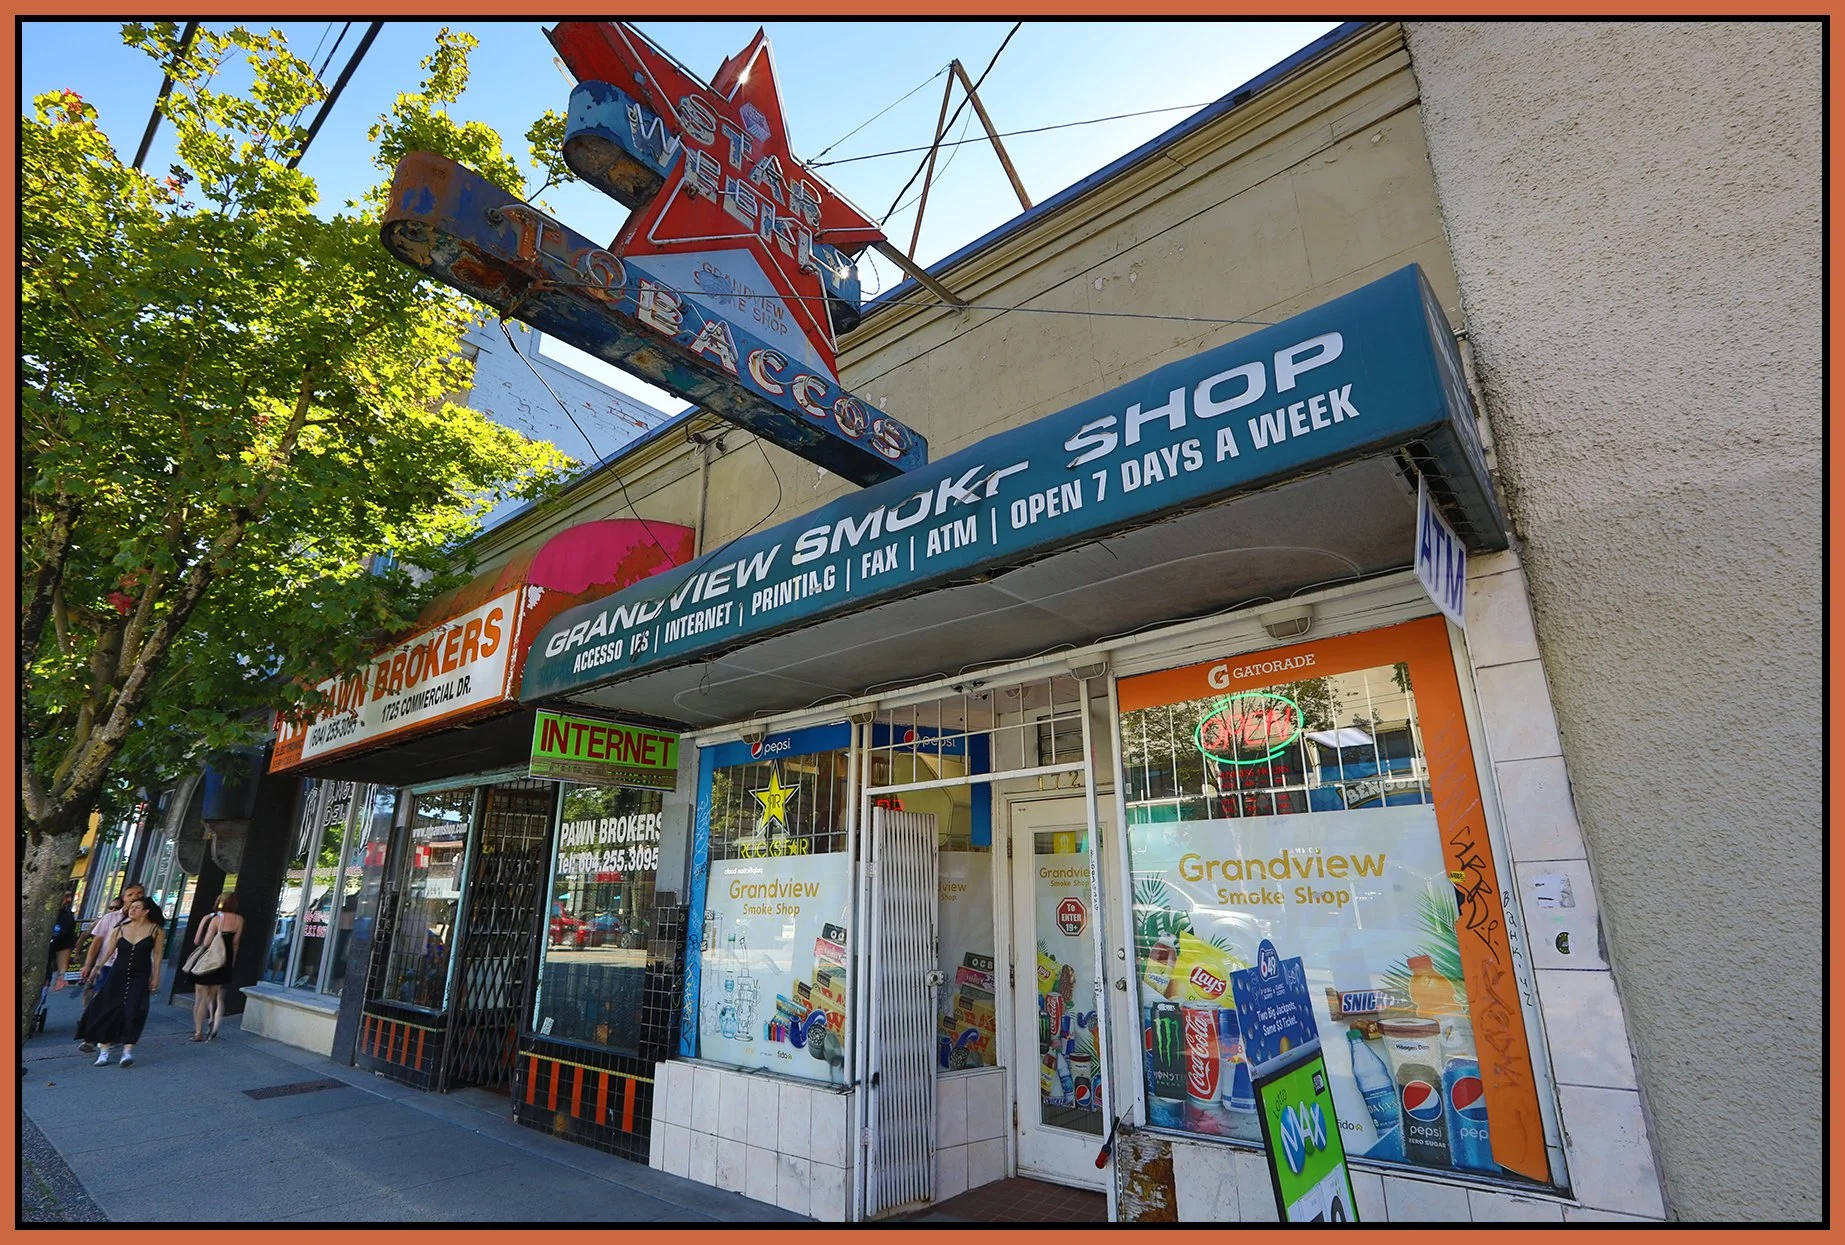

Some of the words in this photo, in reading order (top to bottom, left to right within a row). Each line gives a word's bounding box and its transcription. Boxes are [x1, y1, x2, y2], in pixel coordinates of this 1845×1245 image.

[500, 204, 912, 459] TOBACCOS
[753, 307, 788, 336] SHOP
[1064, 331, 1343, 470] SHOP
[573, 630, 649, 674] ACCESSOIES
[665, 601, 733, 644] INTERNET
[861, 543, 898, 579] FAX
[926, 515, 977, 558] ATM
[1010, 480, 1083, 530] OPEN
[1092, 469, 1108, 502] 7
[1121, 438, 1204, 493] DAYS
[1216, 427, 1239, 462] A
[1248, 383, 1360, 451] WEEK
[1420, 499, 1463, 616] ATM
[371, 607, 503, 702] BROKERS
[1232, 653, 1317, 680] GATORADE
[382, 702, 400, 723] 1725
[400, 683, 454, 716] COMMERCIAL
[456, 675, 472, 697] DR.
[309, 727, 326, 748] (604)
[1202, 706, 1291, 749] OPEN
[540, 718, 675, 767] INTERNET
[764, 737, 791, 756] pepsi
[560, 820, 596, 847] PAWN
[599, 811, 662, 843] BROKERS
[558, 853, 576, 874] Tel:
[577, 847, 659, 873] 604.255.3095
[1178, 850, 1388, 882] Grandview
[1039, 867, 1091, 879] Grandvie
[1050, 879, 1071, 887] Smoke
[729, 878, 819, 900] Grandview
[1217, 887, 1285, 906] Smoke
[1294, 886, 1350, 908] Shop
[743, 903, 772, 915] Smoke
[776, 903, 801, 916] Shop
[1062, 913, 1082, 922] ENTER
[1065, 923, 1079, 931] 19+
[972, 958, 993, 969] OCB
[1257, 1010, 1268, 1021] Two
[1267, 1007, 1276, 1019] Big
[1262, 1025, 1276, 1036] Same
[1276, 1020, 1283, 1032] $3
[777, 1050, 788, 1059] fido
[1273, 1089, 1288, 1119] Lotto
[1281, 1101, 1326, 1174] MAX
[1409, 1125, 1442, 1139] pepsi
[1425, 1140, 1447, 1149] SUGAR
